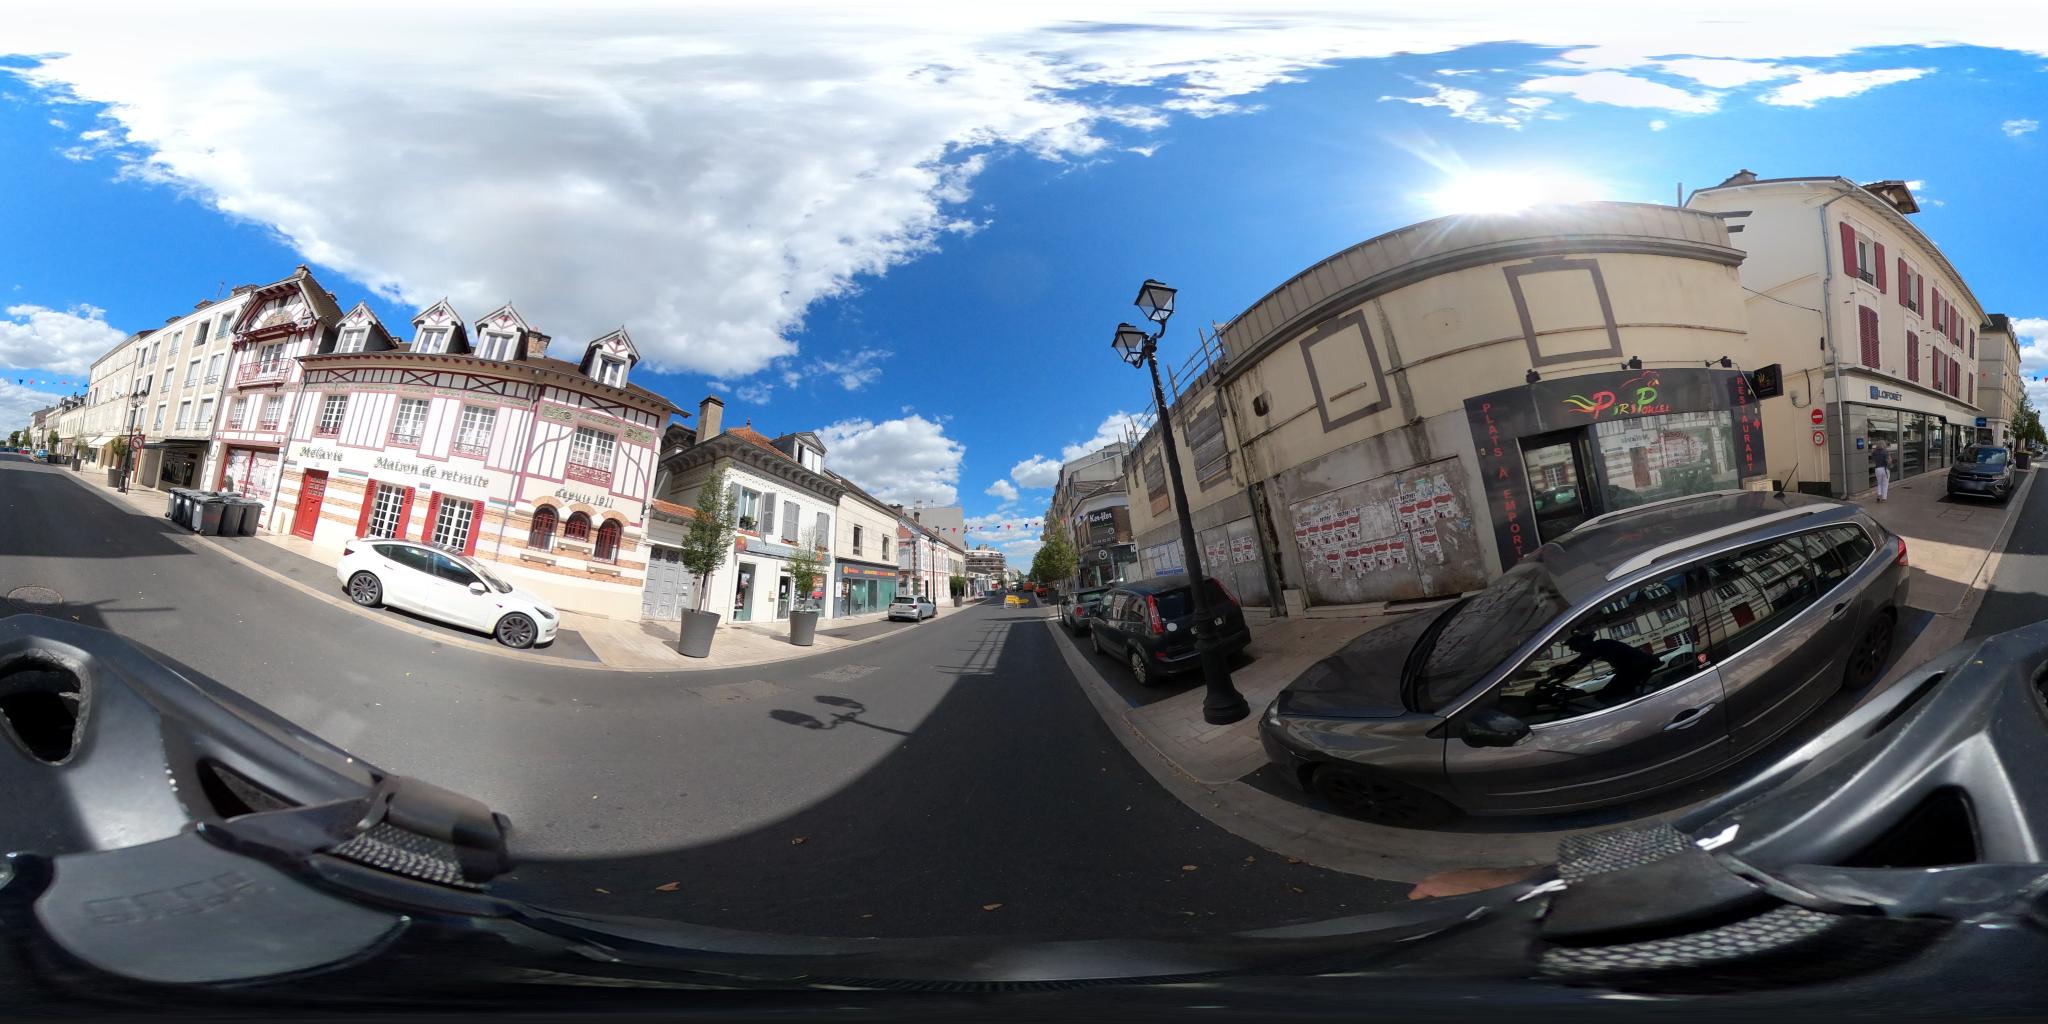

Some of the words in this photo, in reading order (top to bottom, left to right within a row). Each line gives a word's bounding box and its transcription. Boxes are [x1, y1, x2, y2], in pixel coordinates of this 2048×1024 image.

[1736, 376, 1754, 471] RESTAURANT
[374, 456, 419, 474] Maison
[422, 463, 437, 477] de
[440, 468, 490, 488] retraite
[554, 488, 591, 504] depuis
[1482, 403, 1503, 457] PLATS
[1503, 489, 1524, 558] EMPORT
